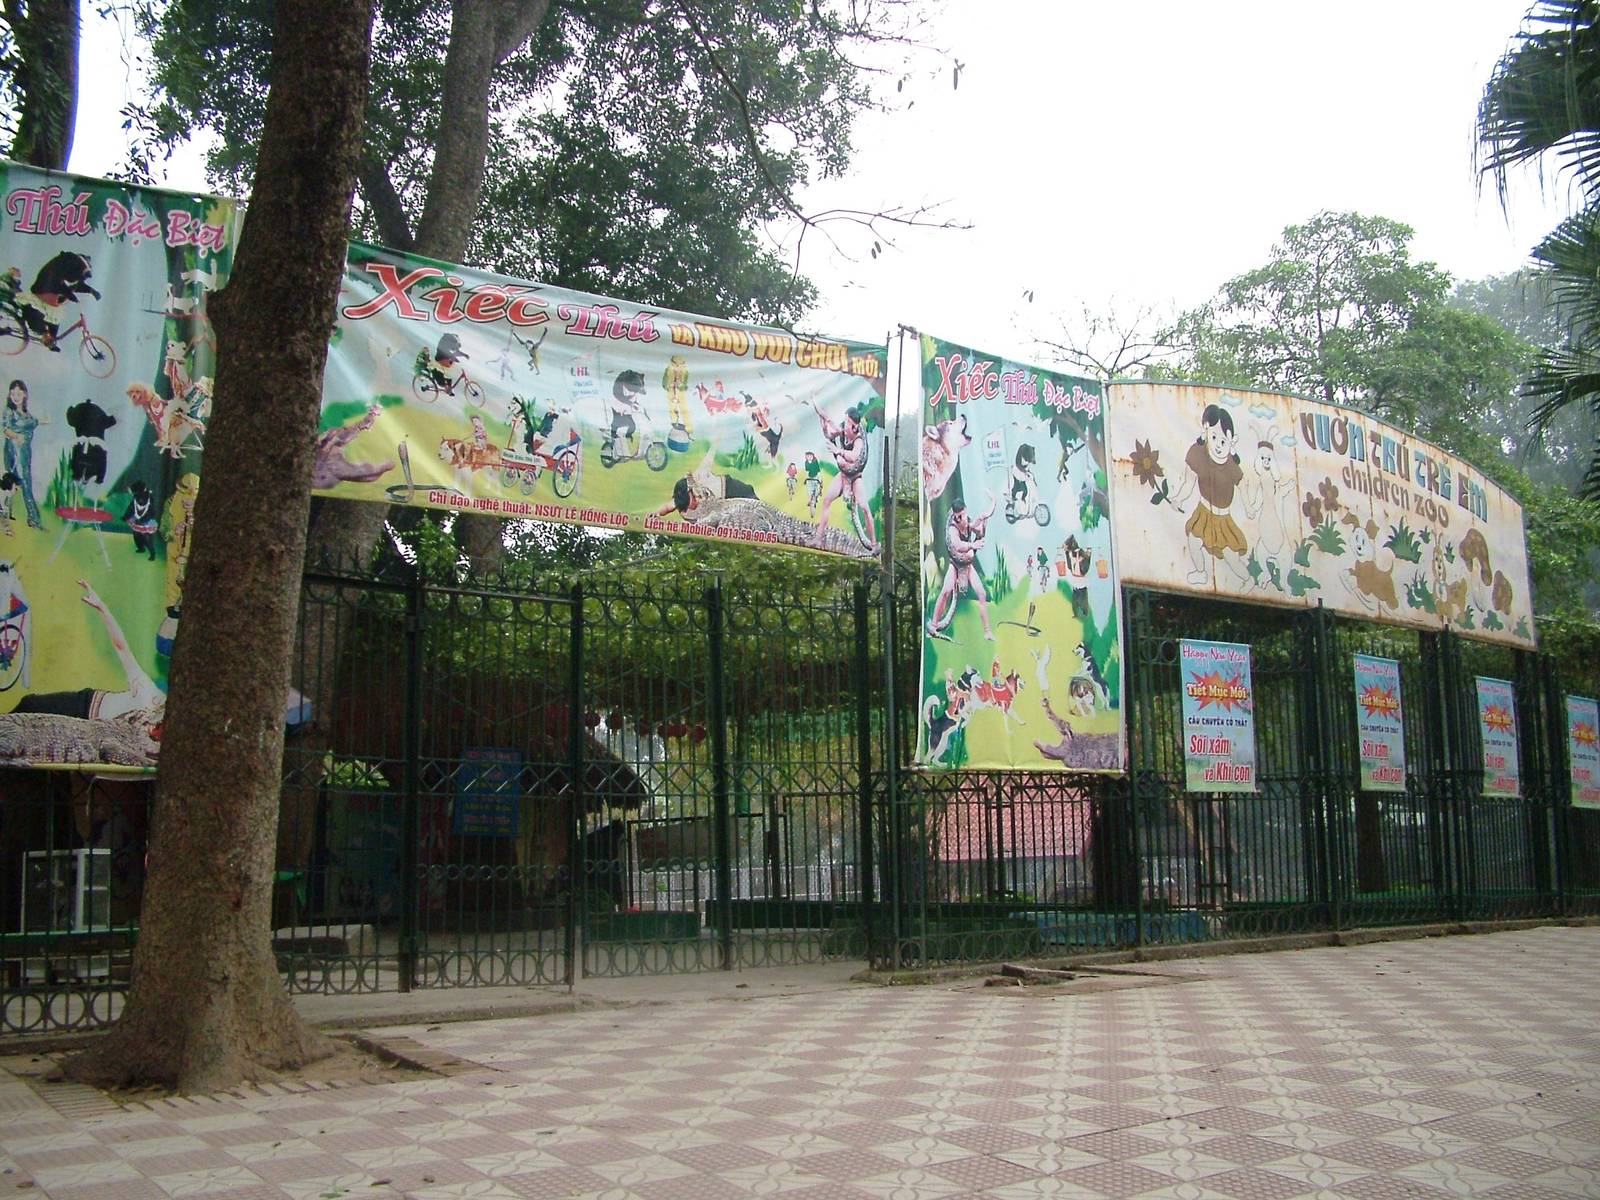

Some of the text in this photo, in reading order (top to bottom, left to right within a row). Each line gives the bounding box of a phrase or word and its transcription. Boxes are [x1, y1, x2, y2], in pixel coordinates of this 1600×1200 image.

[7, 185, 226, 258] Thú Đặc Biệt
[342, 263, 550, 326] Xiếc
[557, 304, 660, 342] Thú
[695, 322, 750, 356] KHU
[752, 331, 793, 365] VUI
[930, 354, 1100, 420] Xiếc Thú Đặc Biệt
[1342, 460, 1449, 528] children zoo
[1234, 766, 1250, 781] con
